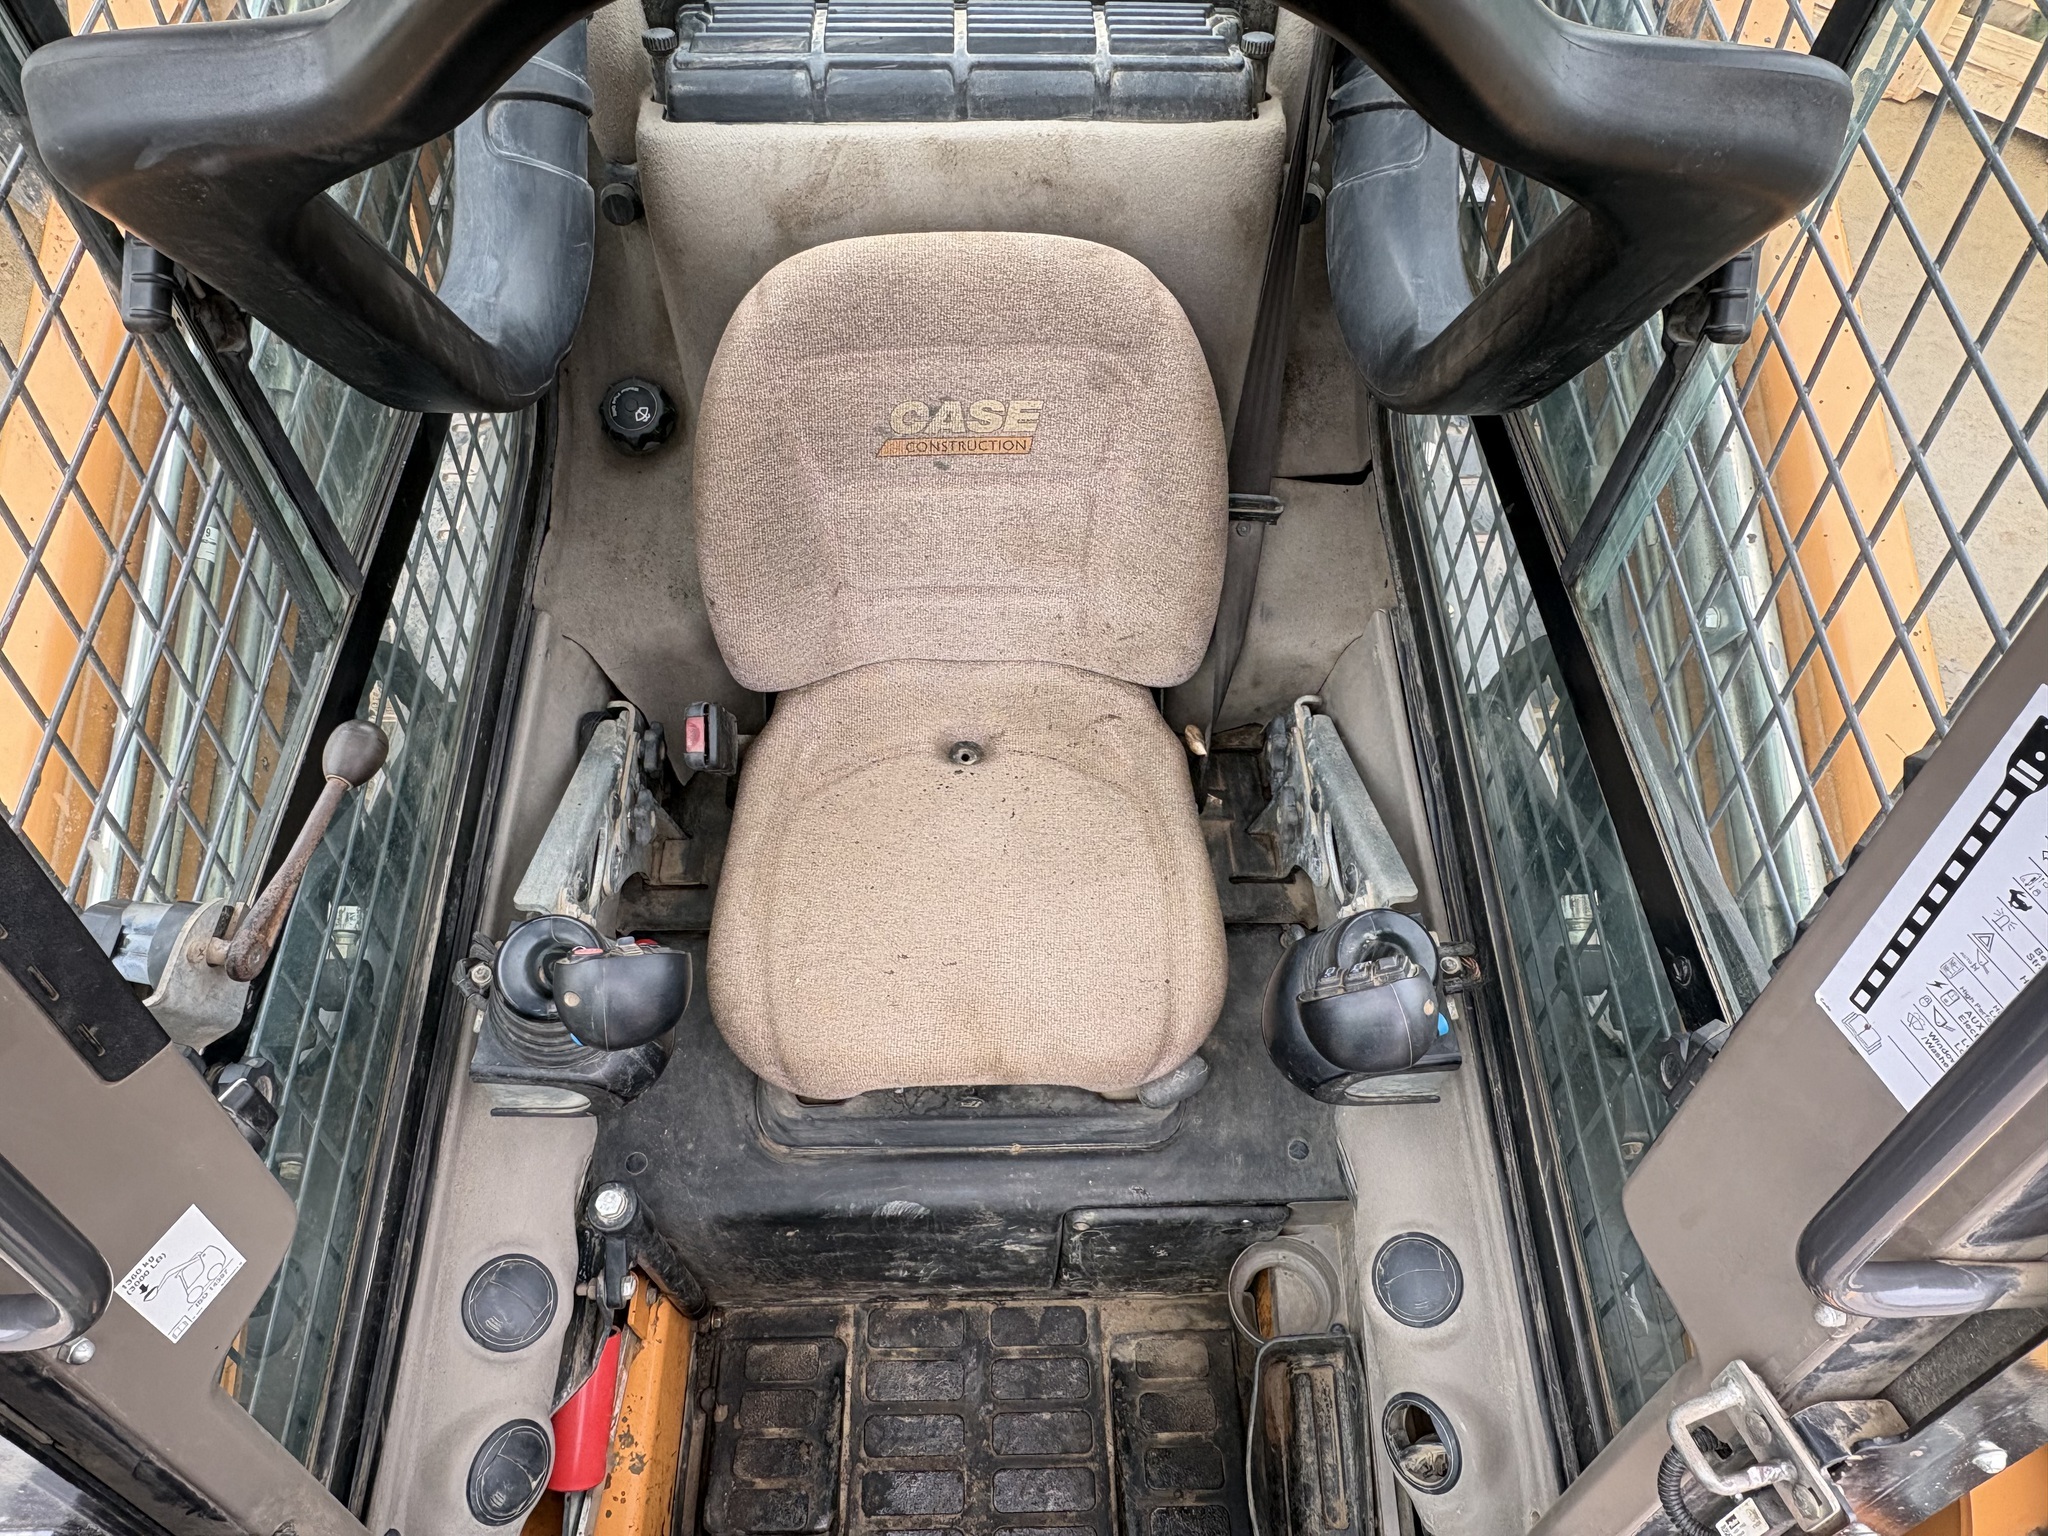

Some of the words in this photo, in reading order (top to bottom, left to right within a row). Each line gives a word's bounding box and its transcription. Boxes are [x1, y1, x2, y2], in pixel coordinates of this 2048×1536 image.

[889, 399, 1044, 434] CASE
[906, 439, 1027, 453] CONSTRUCTION
[1964, 1009, 1985, 1031] AUX
